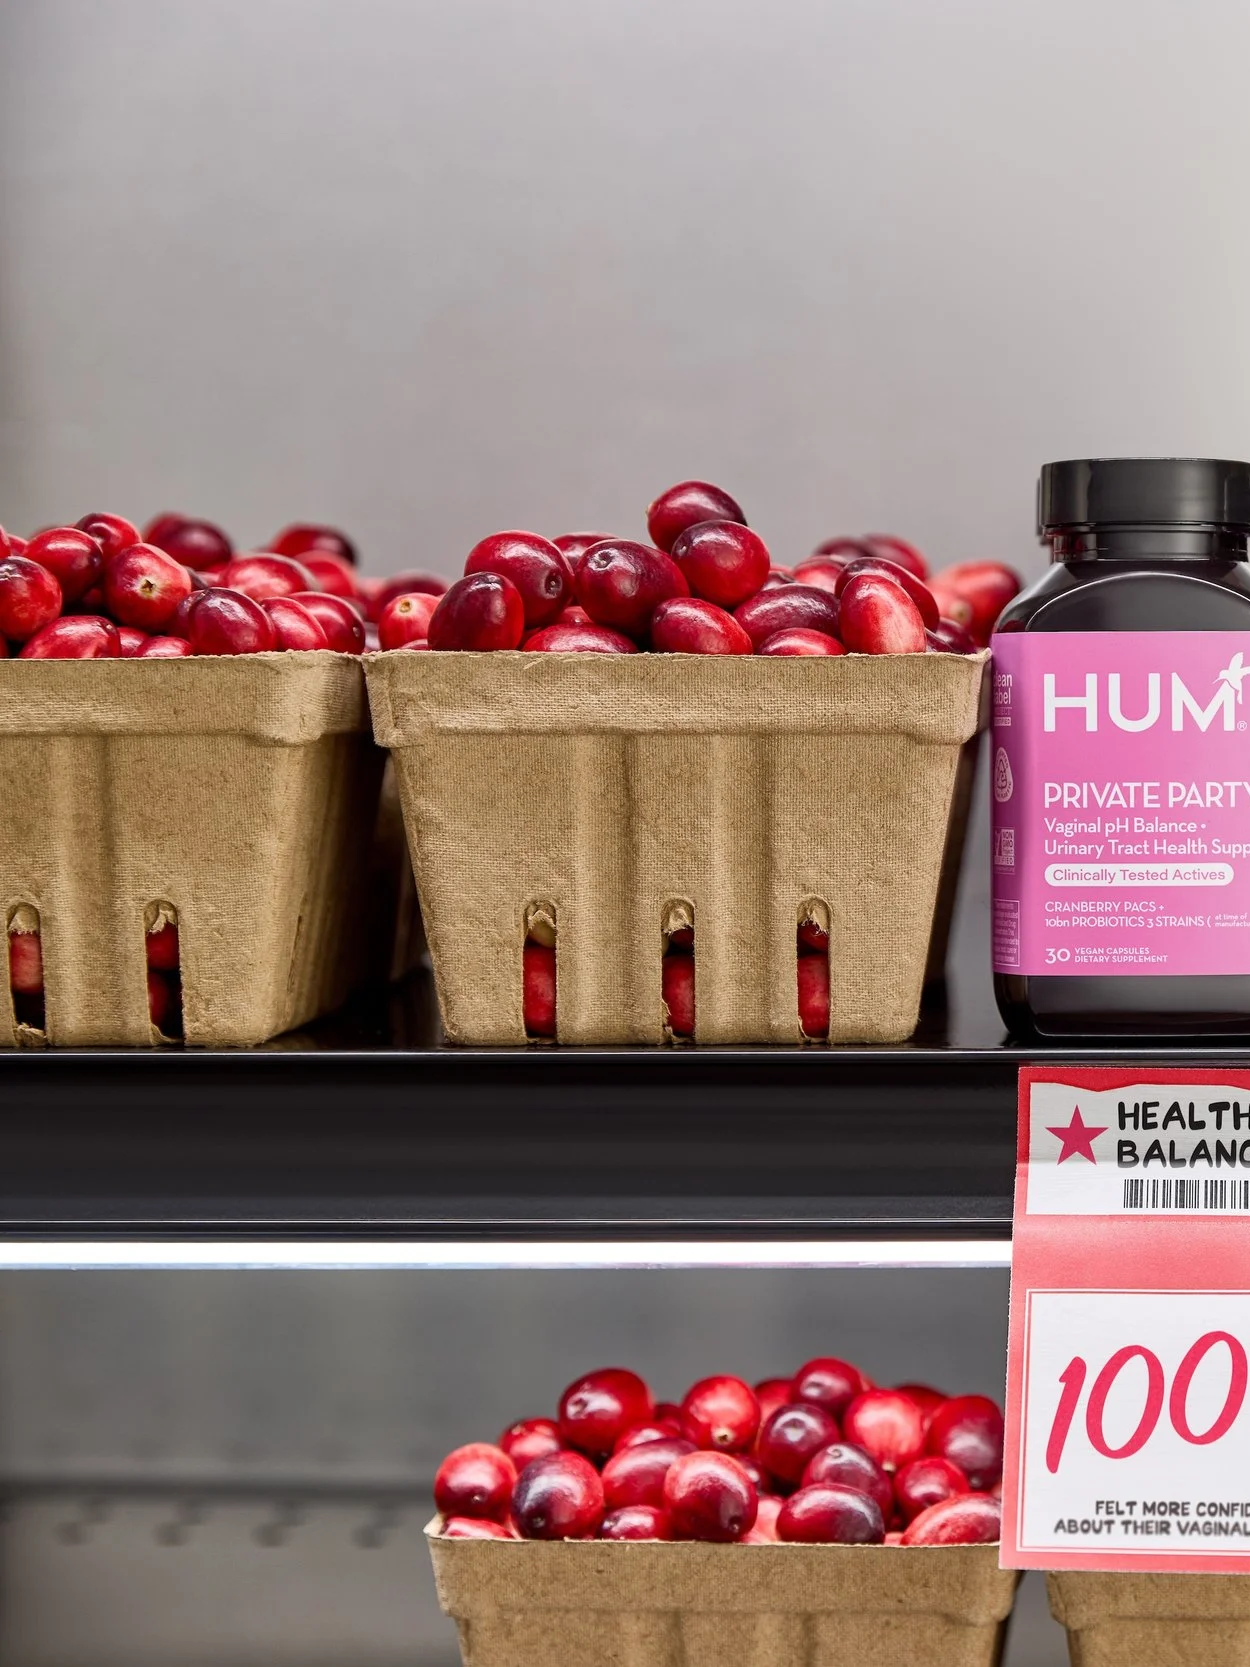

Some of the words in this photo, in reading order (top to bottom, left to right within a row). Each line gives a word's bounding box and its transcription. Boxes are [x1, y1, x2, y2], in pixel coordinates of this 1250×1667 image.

[993, 687, 1012, 705] abel
[1044, 781, 1161, 809] PRIVATE
[1044, 817, 1102, 837] Vaginal
[1105, 818, 1130, 837] pH
[1133, 817, 1198, 833] Balance
[1044, 839, 1103, 860] Urinary
[1107, 839, 1150, 855] Tract
[1153, 838, 1209, 855] Health
[1052, 868, 1117, 884] Clinically
[1120, 868, 1169, 881] Tested
[1172, 868, 1226, 881] Actives
[1044, 900, 1121, 913] CRANBERRY
[1123, 900, 1157, 913] PACS
[1044, 916, 1070, 928] 10bn
[1072, 915, 1145, 928] PROBIOTICS
[1146, 916, 1154, 929] 3
[1155, 915, 1204, 928] STRAINS
[1214, 913, 1222, 921] at
[1224, 913, 1239, 921] time
[1239, 912, 1248, 921] of
[1044, 947, 1071, 965] 30
[1074, 947, 1105, 955] VEGAN
[1106, 947, 1150, 955] CAPSULES
[1074, 955, 1111, 963] DIETARY
[1112, 955, 1168, 963] SUPPLEMENT
[1095, 1500, 1138, 1516] FELT
[1142, 1500, 1190, 1517] MORE
[1053, 1519, 1115, 1535] ABOUT
[1121, 1520, 1171, 1536] THEIR
